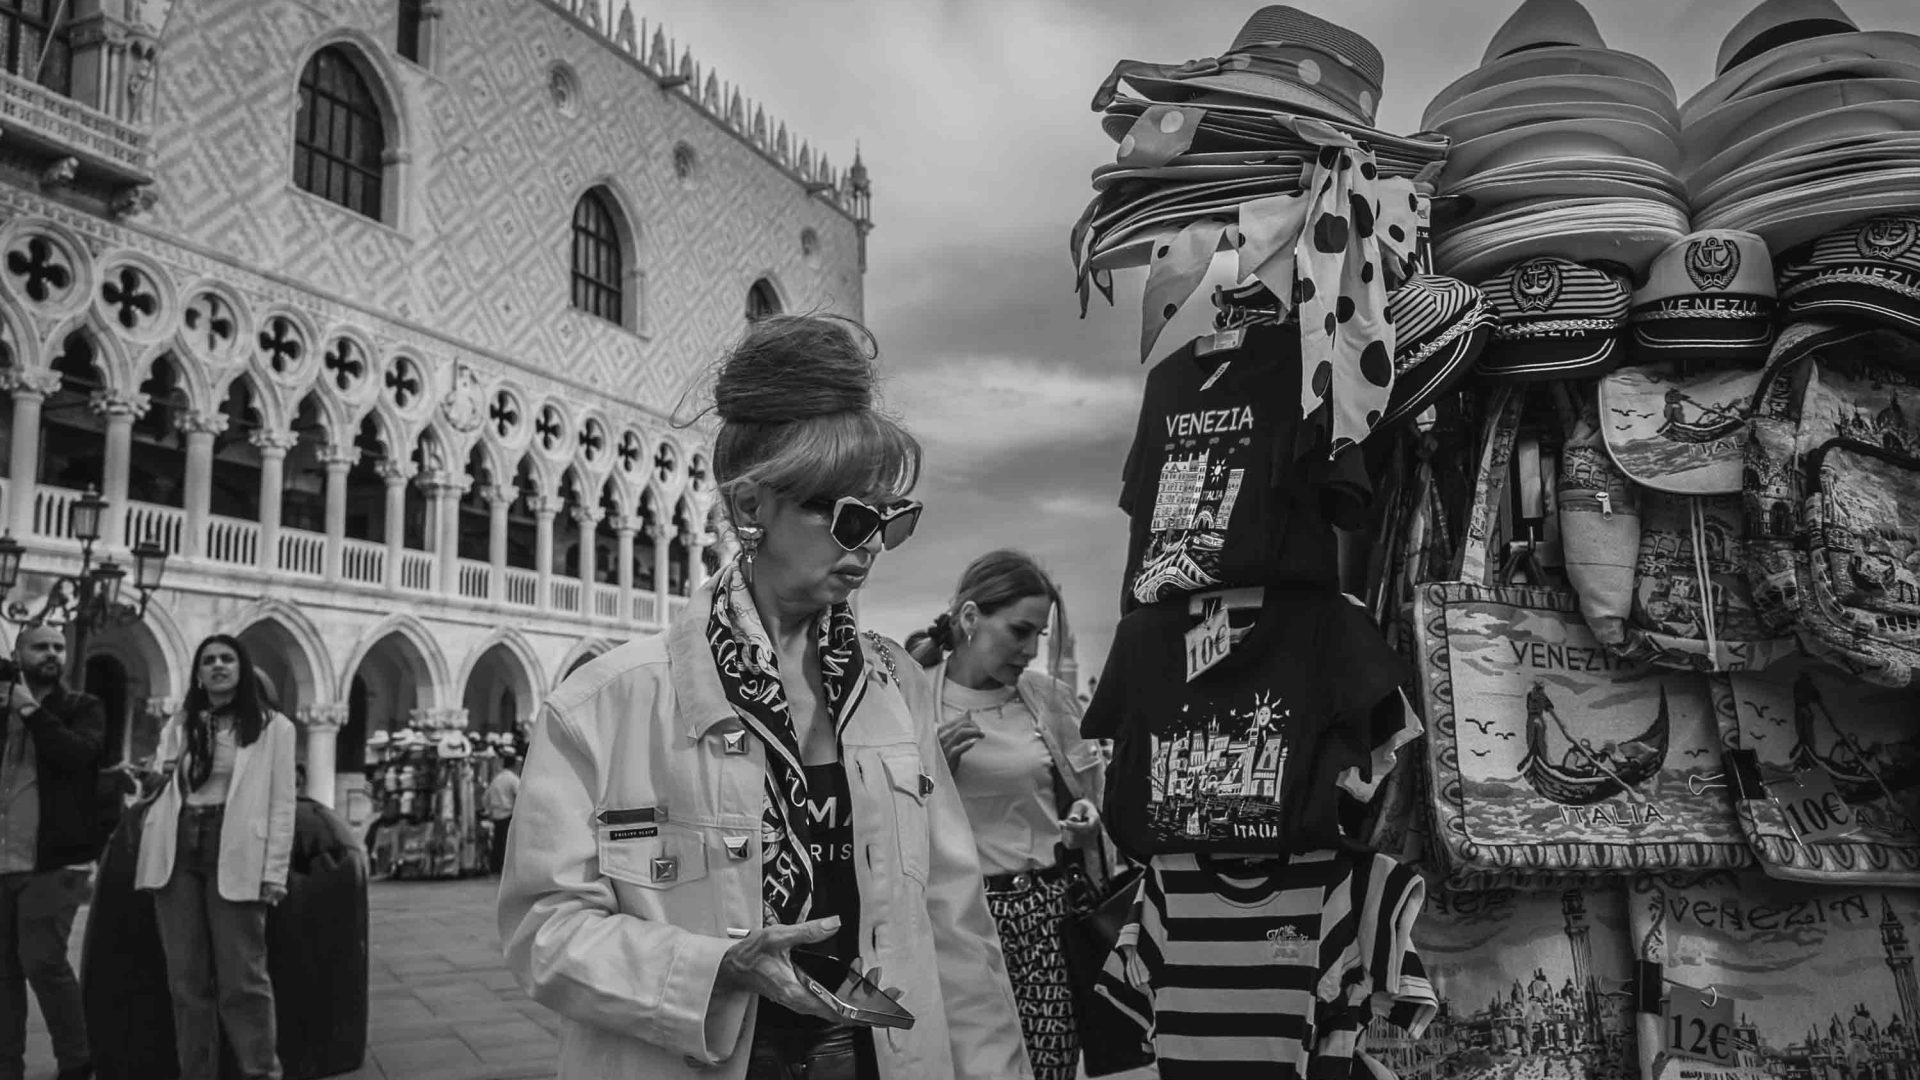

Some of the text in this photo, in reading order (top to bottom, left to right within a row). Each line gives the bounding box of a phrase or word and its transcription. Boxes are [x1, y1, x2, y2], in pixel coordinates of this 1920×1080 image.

[1166, 405, 1254, 438] VENEZIA
[1187, 624, 1229, 676] 10€
[1234, 823, 1279, 839] ITALIA
[1558, 803, 1665, 827] ITALIA
[1786, 791, 1850, 837] 10€
[1670, 1013, 1732, 1060] 12€
